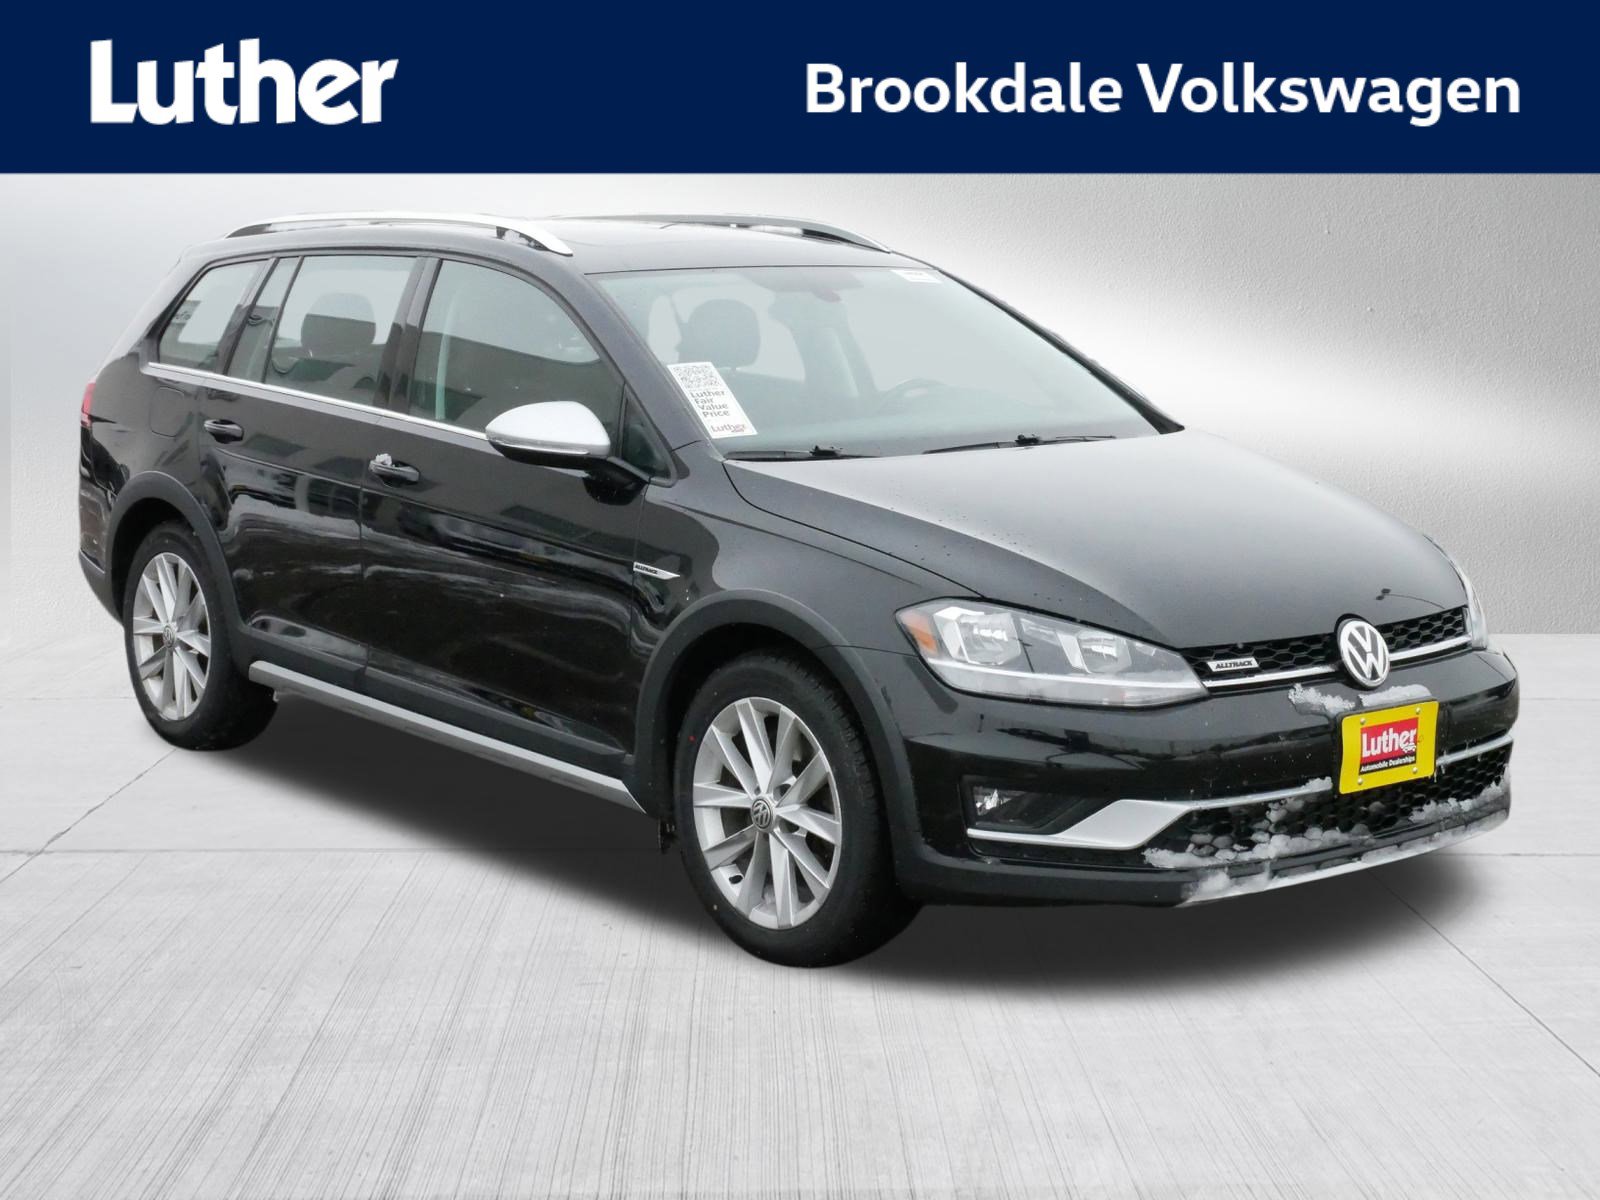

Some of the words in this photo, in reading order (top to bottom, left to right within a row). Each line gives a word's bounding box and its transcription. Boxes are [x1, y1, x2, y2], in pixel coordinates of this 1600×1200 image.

[690, 390, 725, 398] Luther
[1215, 659, 1253, 670] ALLTRACK
[1362, 728, 1416, 758] Luther
